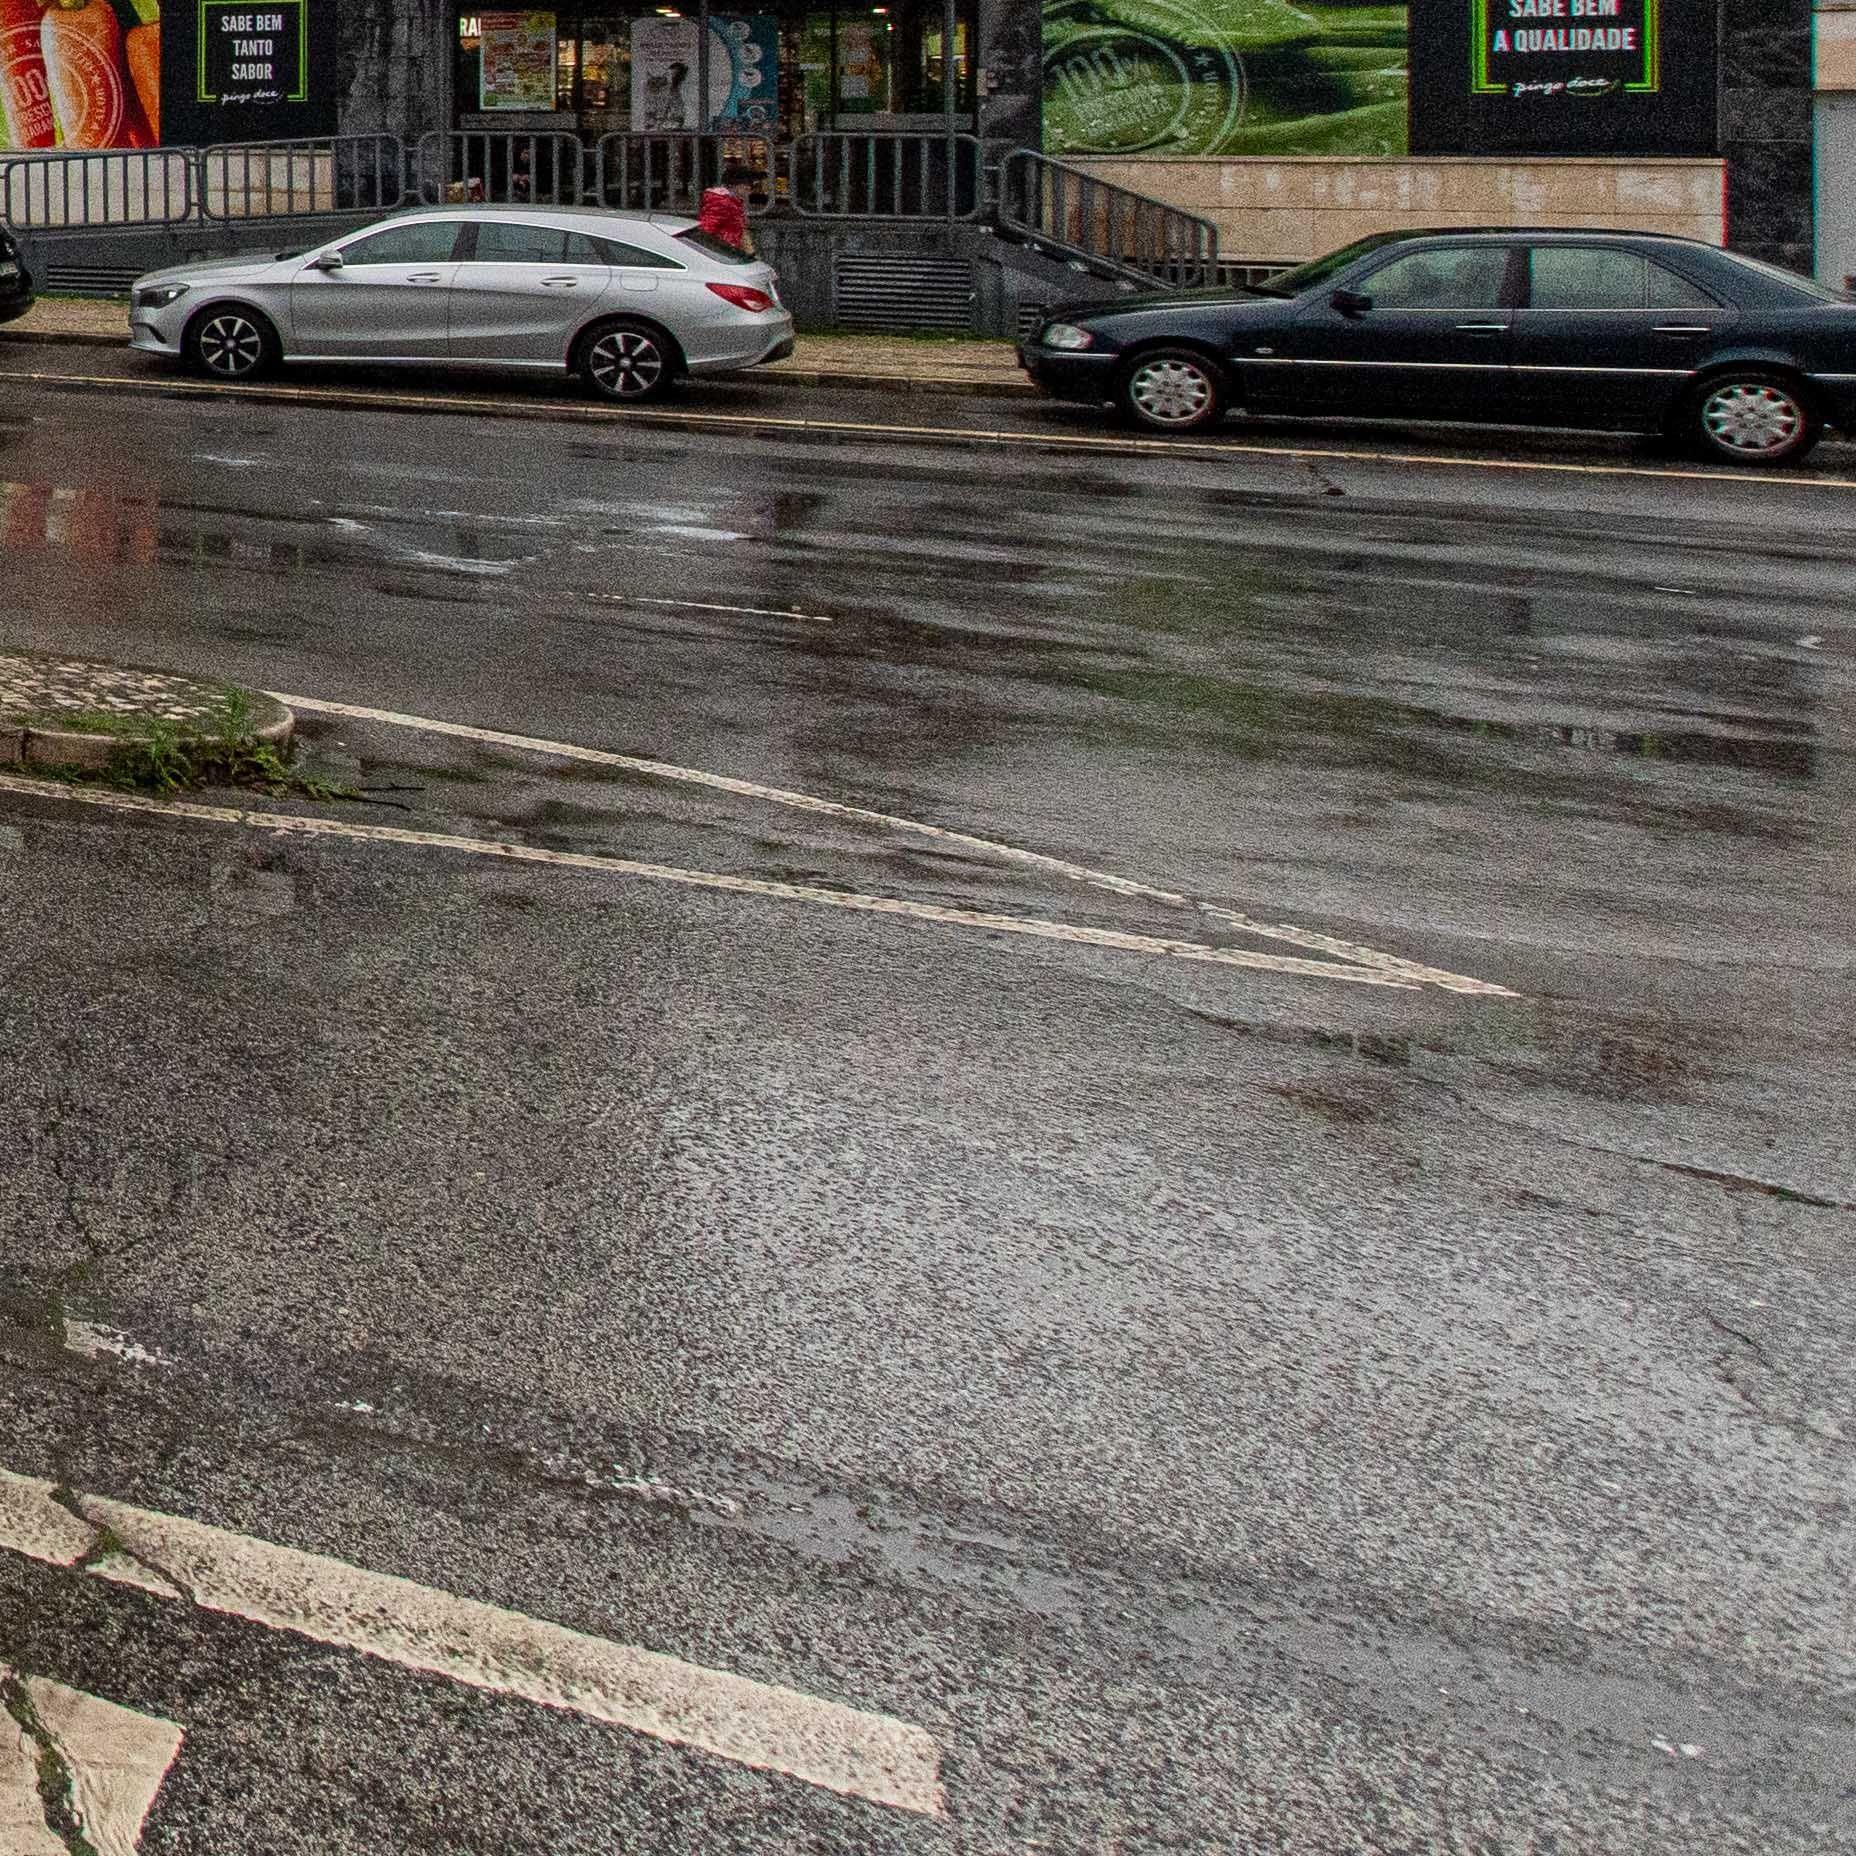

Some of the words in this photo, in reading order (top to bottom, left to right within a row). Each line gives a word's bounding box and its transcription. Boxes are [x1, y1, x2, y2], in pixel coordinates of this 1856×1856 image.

[221, 15, 253, 32] SABE
[256, 14, 283, 31] BEM
[232, 39, 273, 56] TANTO
[1493, 29, 1510, 52] A
[1513, 27, 1637, 52] QUALIDADE
[232, 63, 273, 80] SABOR
[1513, 80, 1564, 97] pingo
[1566, 76, 1611, 89] doce
